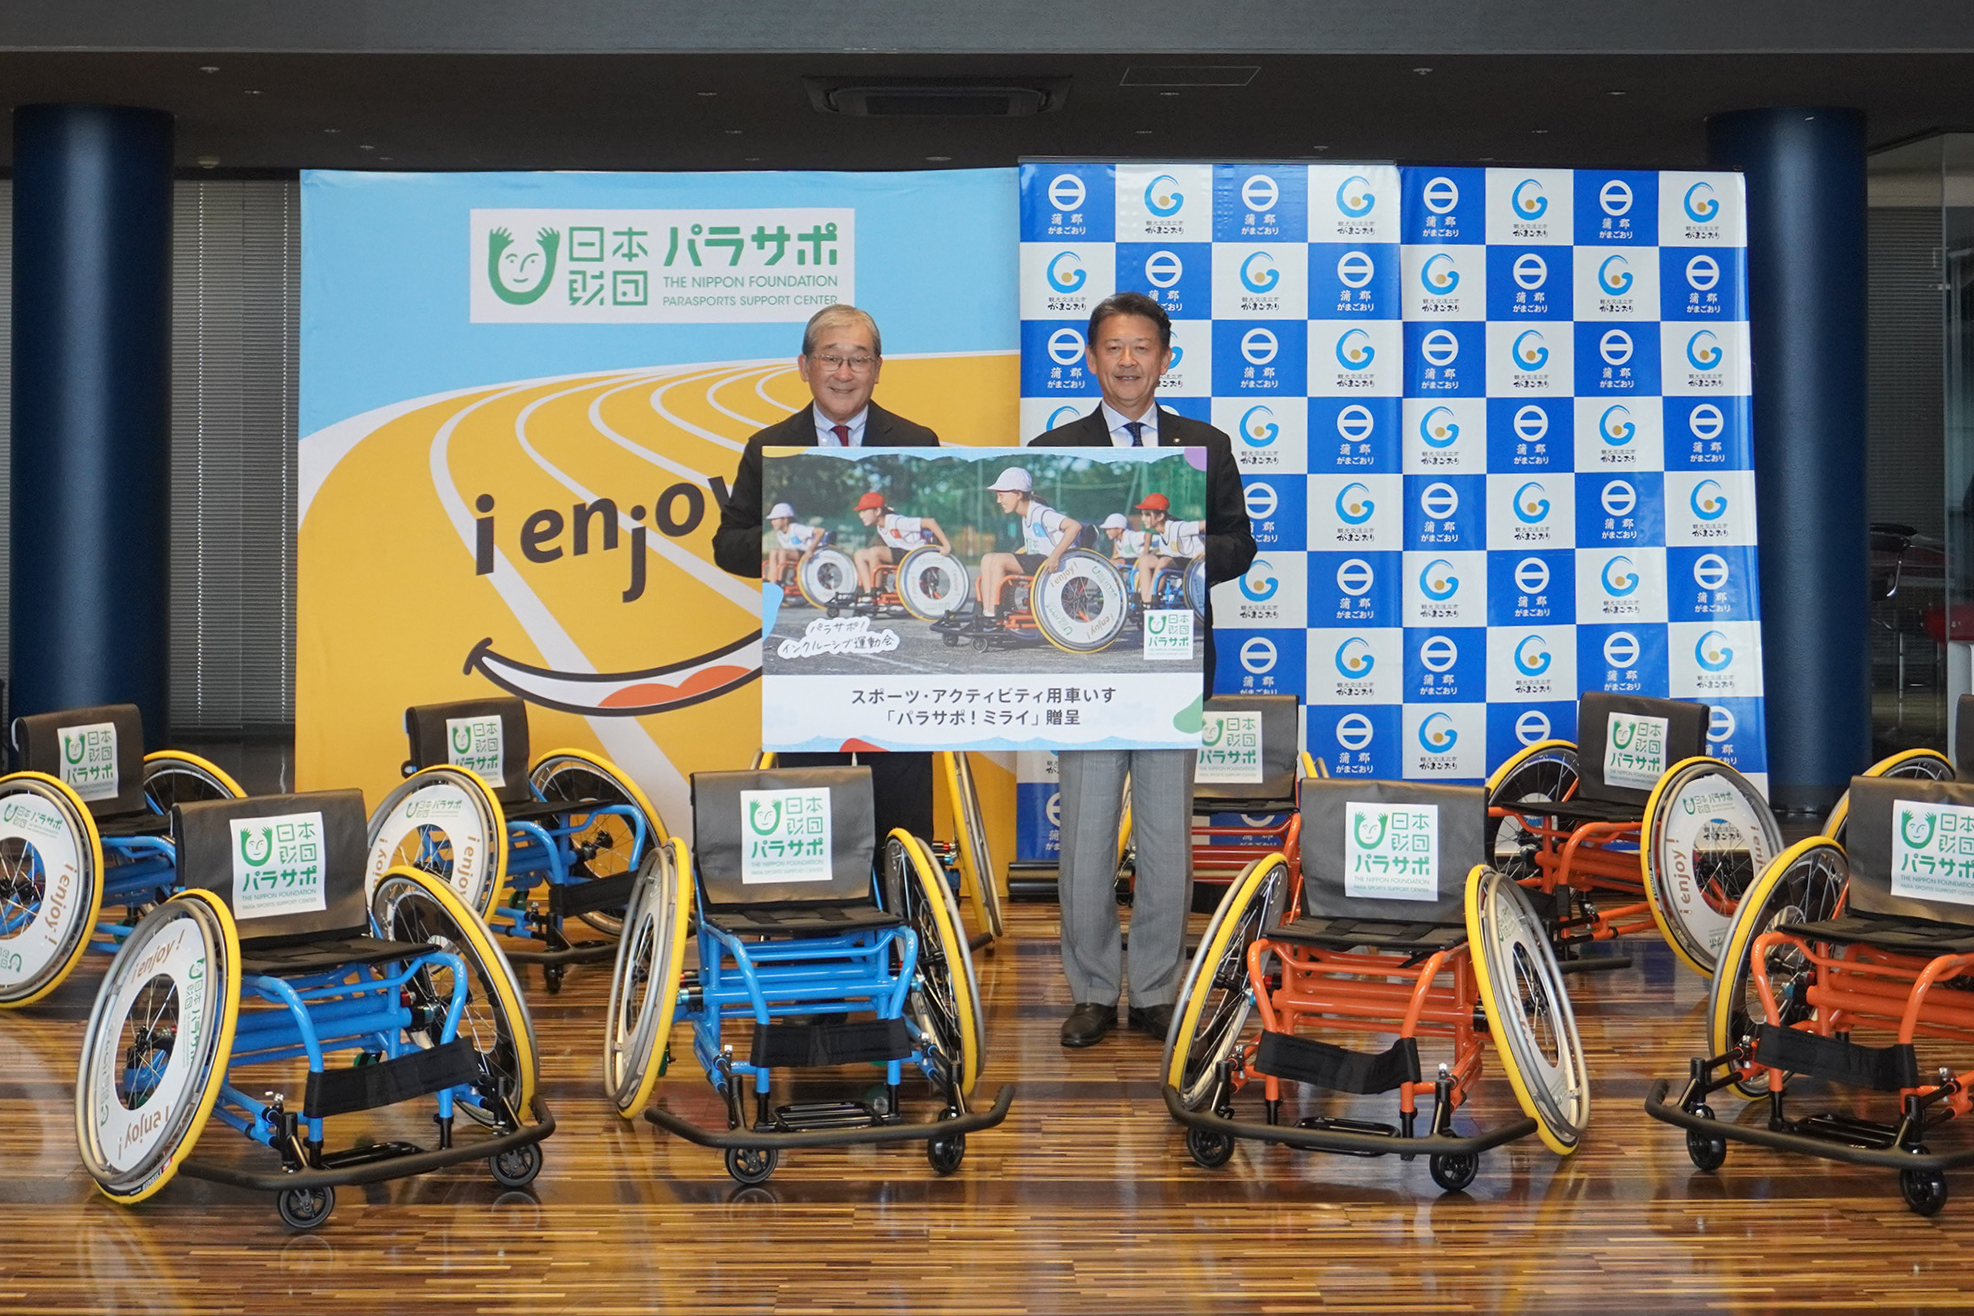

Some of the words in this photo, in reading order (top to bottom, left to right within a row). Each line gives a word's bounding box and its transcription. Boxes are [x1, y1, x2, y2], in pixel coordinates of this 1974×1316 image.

[1047, 227, 1086, 235] がまごおり
[1241, 227, 1279, 235] がまごおり
[1422, 229, 1459, 237] がまごおり
[1599, 231, 1633, 239] がまごおり
[568, 226, 648, 262] 日本
[663, 222, 838, 267] パラサポ
[663, 275, 687, 288] THE
[692, 275, 745, 288] NIPPON
[749, 275, 838, 288] FOUNDATION
[568, 270, 648, 306] 財団
[662, 296, 736, 306] PARASPORTS
[739, 296, 791, 306] SUPPORT
[794, 295, 838, 306] CENTER
[1336, 303, 1375, 311] がまごおり
[1512, 305, 1548, 313] がまごおり
[1686, 305, 1721, 313] がまごおり
[1047, 381, 1086, 389] がまごおり
[1240, 380, 1279, 388] がまごおり
[1421, 381, 1459, 389] がまごおり
[1599, 380, 1635, 388] がまごおり
[1336, 457, 1374, 465] がまごおり
[1513, 457, 1549, 465] がまごおり
[1689, 455, 1726, 463] がまごおり
[475, 493, 495, 576] i
[1420, 534, 1459, 542] がまごおり
[1601, 531, 1639, 539] がまごおり
[1514, 609, 1551, 617] がまごおり
[1694, 605, 1731, 613] がまごおり
[1336, 611, 1374, 619] がまごおり
[1148, 636, 1190, 647] パラサポ
[1419, 687, 1458, 695] がまごおり
[1604, 683, 1641, 691] がまごおり
[851, 687, 1117, 704] スポーツ・アクティビティ用車いす
[1226, 717, 1256, 731] 日本
[1637, 722, 1662, 737] 日本
[87, 730, 112, 746] 日本
[455, 754, 498, 770] パラサポ
[1199, 749, 1257, 764] パラサポ
[1610, 752, 1660, 772] パラサポ
[66, 763, 113, 784] パラサポ
[1335, 765, 1374, 773] がまごおり
[785, 796, 823, 815] 日本
[1391, 812, 1430, 831] 日本
[1940, 813, 1974, 833] 日本
[276, 822, 316, 843] 日本
[751, 837, 824, 858] パラサポ
[1391, 833, 1430, 852] 財団
[1354, 853, 1430, 875] パラサポ
[1901, 853, 1974, 879] パラサポ
[242, 865, 317, 892] パラサポ
[1391, 877, 1430, 885] FOUNDATION
[1912, 876, 1937, 884] NIPPON
[253, 892, 277, 901] NIPPON
[278, 888, 317, 898] FOUNDATION
